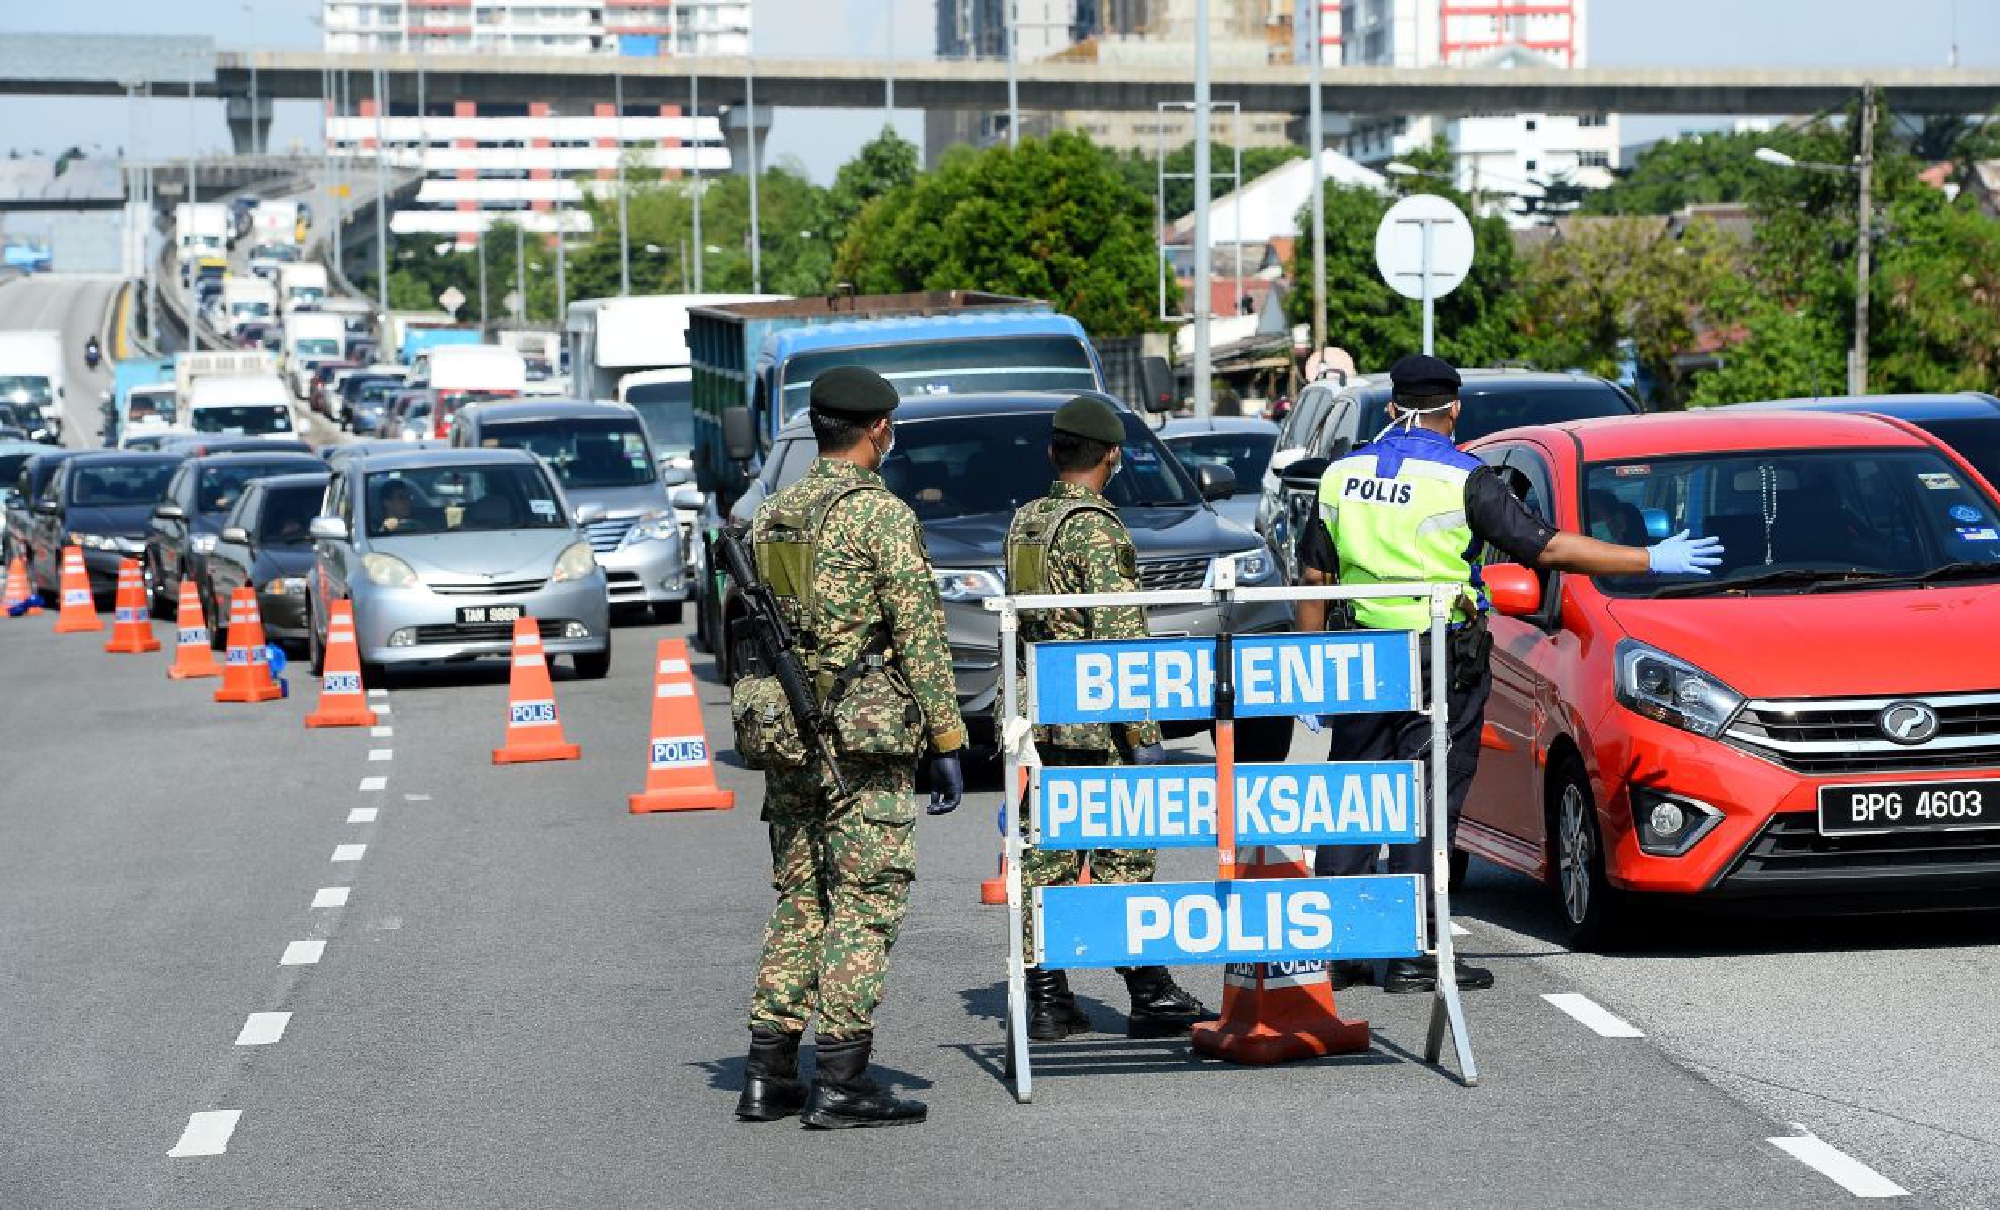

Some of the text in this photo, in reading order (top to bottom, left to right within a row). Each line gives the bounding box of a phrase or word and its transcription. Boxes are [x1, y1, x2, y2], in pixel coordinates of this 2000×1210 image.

[1344, 477, 1412, 504] POLIS
[512, 704, 554, 723] POLIS
[653, 742, 704, 762] POLIS
[1046, 772, 1408, 839] PEMERKSAAN
[1852, 790, 1982, 822] BPG 4603
[1125, 890, 1333, 955] POLIS
